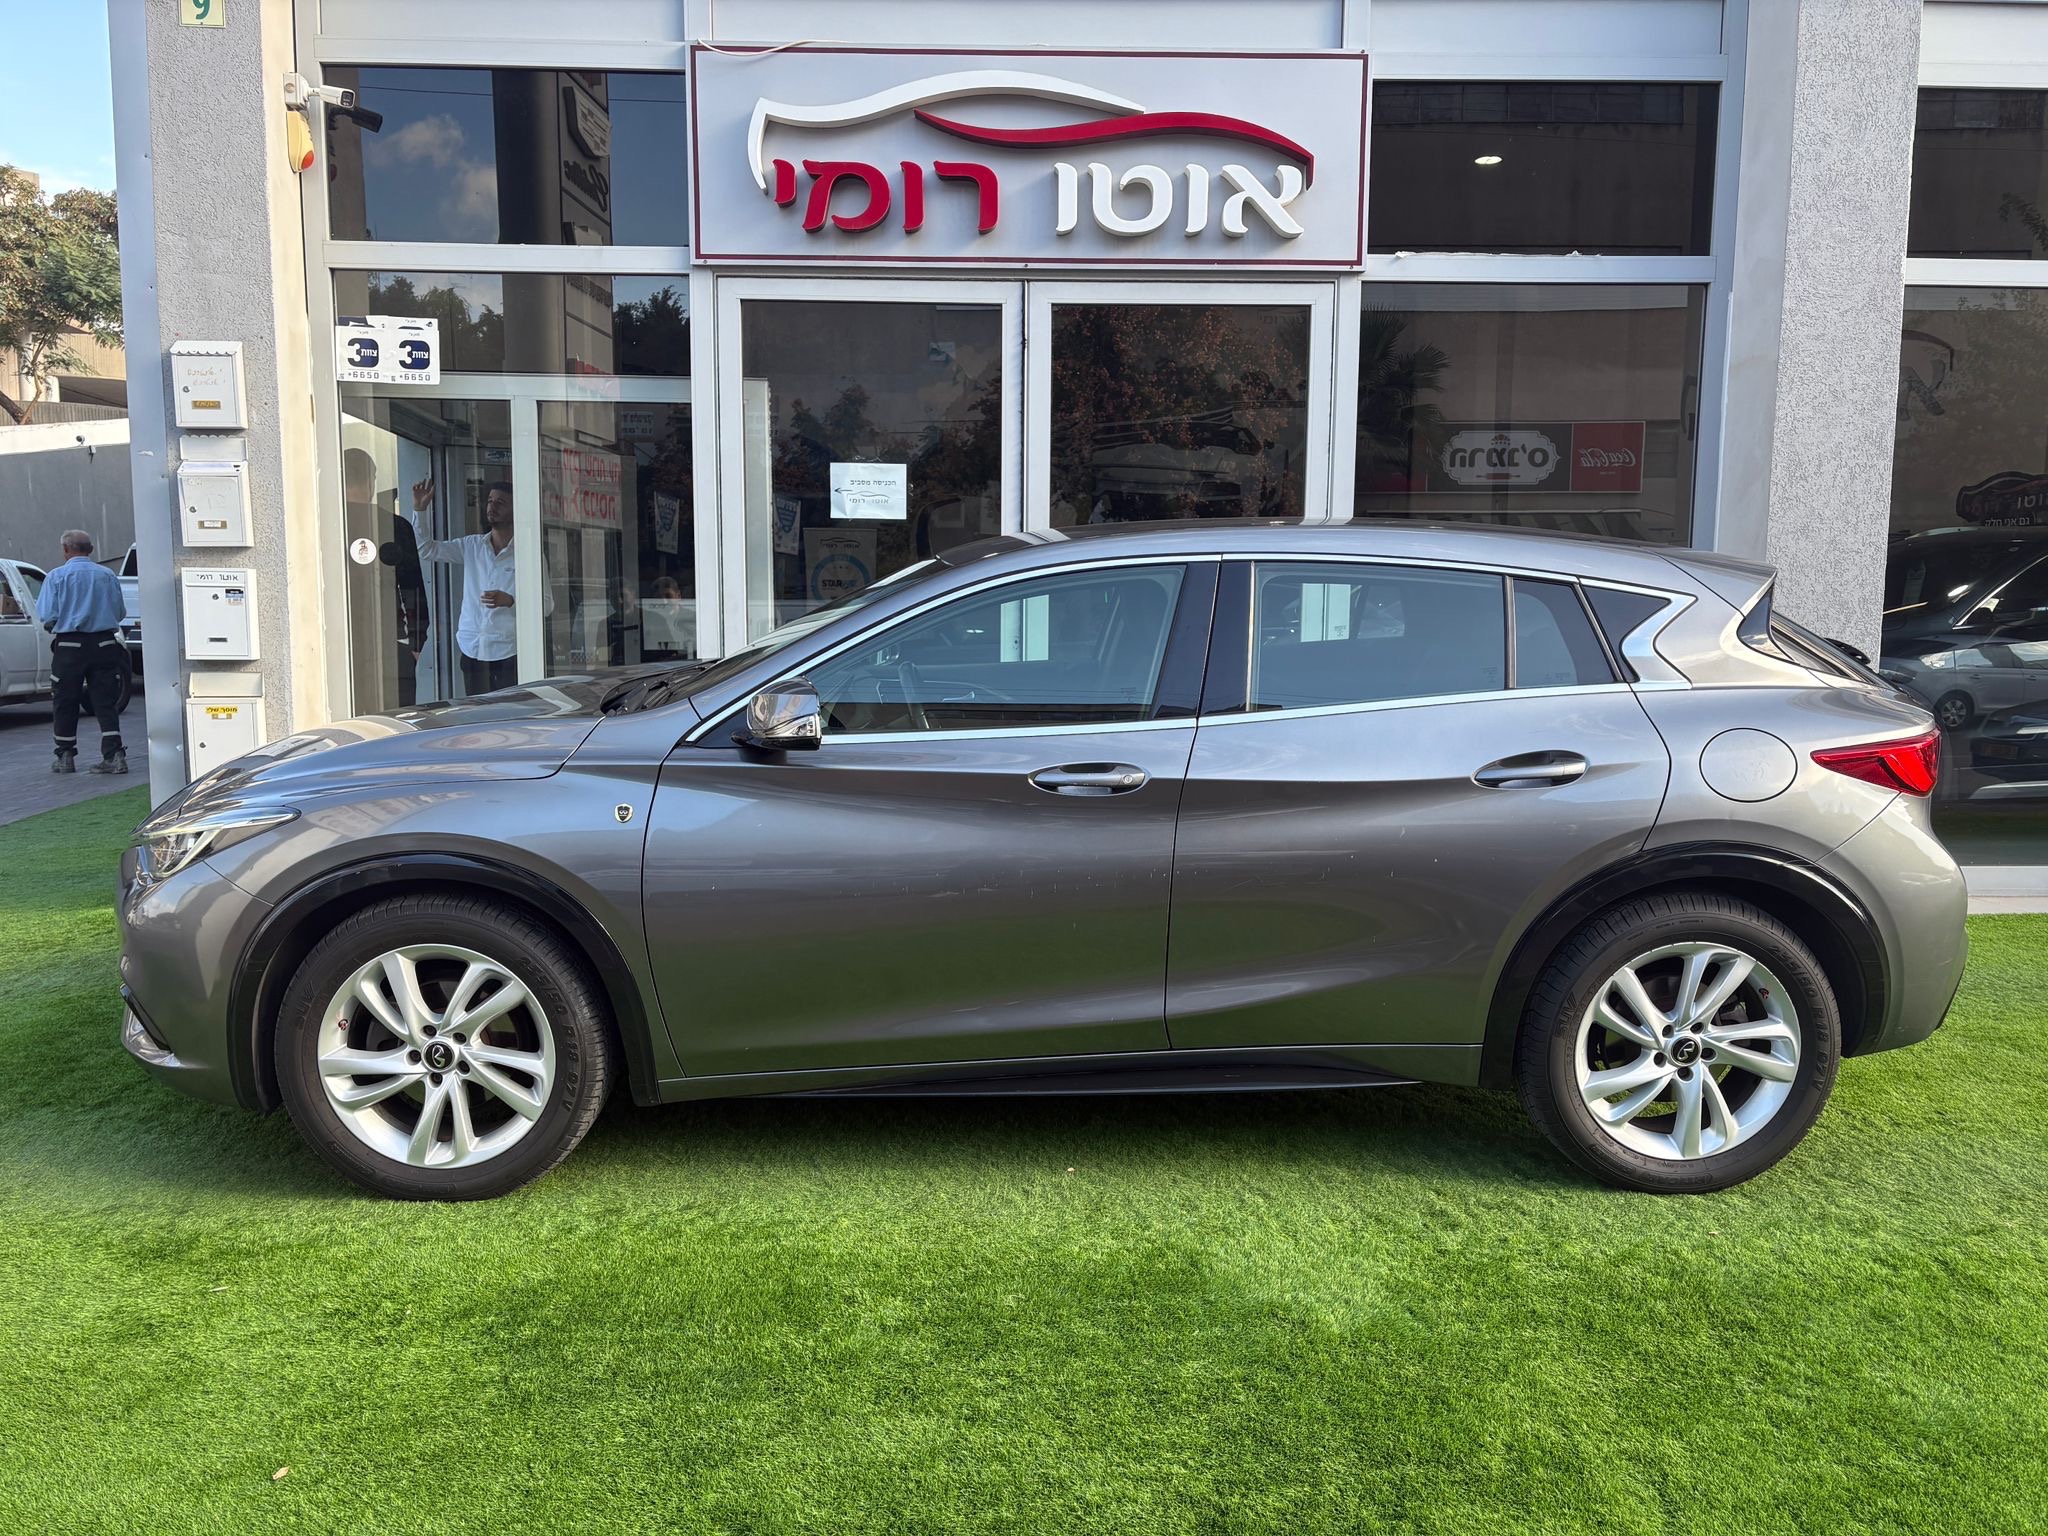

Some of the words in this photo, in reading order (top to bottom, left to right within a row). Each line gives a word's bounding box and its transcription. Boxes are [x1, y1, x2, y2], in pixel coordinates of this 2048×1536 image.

[772, 159, 999, 234] רומי
[1054, 162, 1305, 239] אוטו
[361, 348, 378, 357] צוות
[412, 351, 429, 359] צוות
[2016, 493, 2048, 509] וטו
